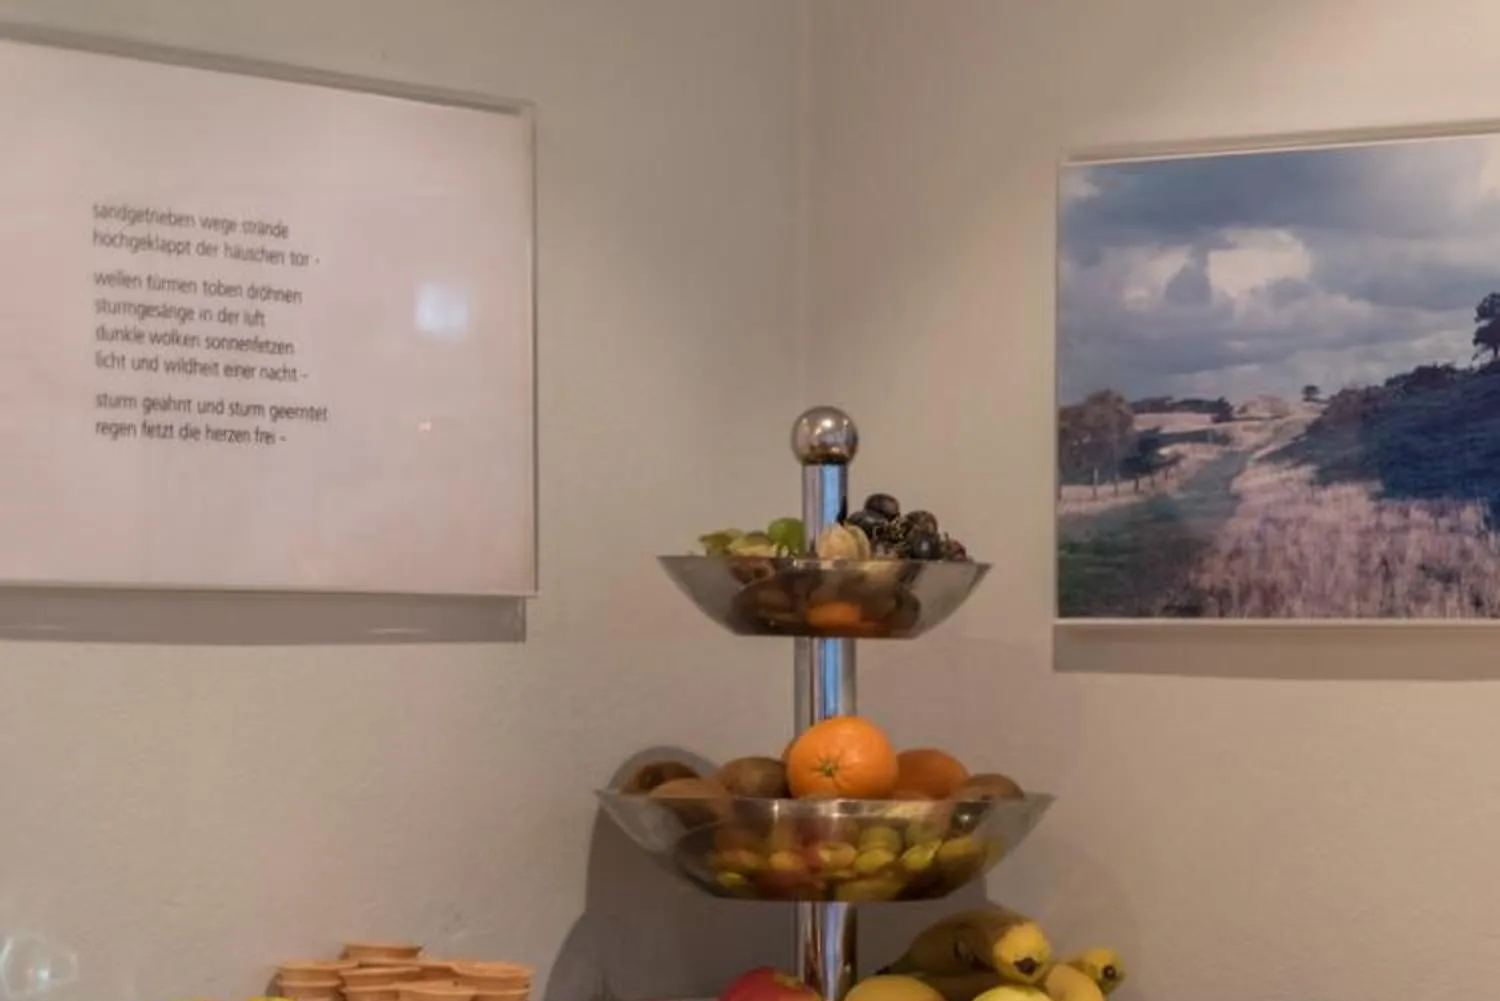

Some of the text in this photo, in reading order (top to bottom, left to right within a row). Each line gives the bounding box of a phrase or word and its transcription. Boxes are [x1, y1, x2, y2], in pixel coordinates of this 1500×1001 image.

[196, 240, 219, 257] der
[202, 279, 243, 298] toben
[199, 307, 213, 321] in
[218, 306, 240, 325] der
[243, 309, 265, 327] luft
[96, 325, 145, 344] dunkle
[149, 328, 200, 348] wolken
[96, 350, 126, 369] licht
[131, 355, 159, 372] und
[164, 357, 220, 377] wildheit
[223, 363, 256, 380] einer
[259, 364, 298, 382] nacht
[96, 393, 138, 409] sturm
[143, 393, 192, 415] geahnt
[197, 399, 225, 415] und
[228, 401, 265, 418] sturm
[96, 421, 138, 440] regen
[179, 421, 202, 441] die
[205, 423, 251, 443] herzen
[254, 425, 276, 445] frei
